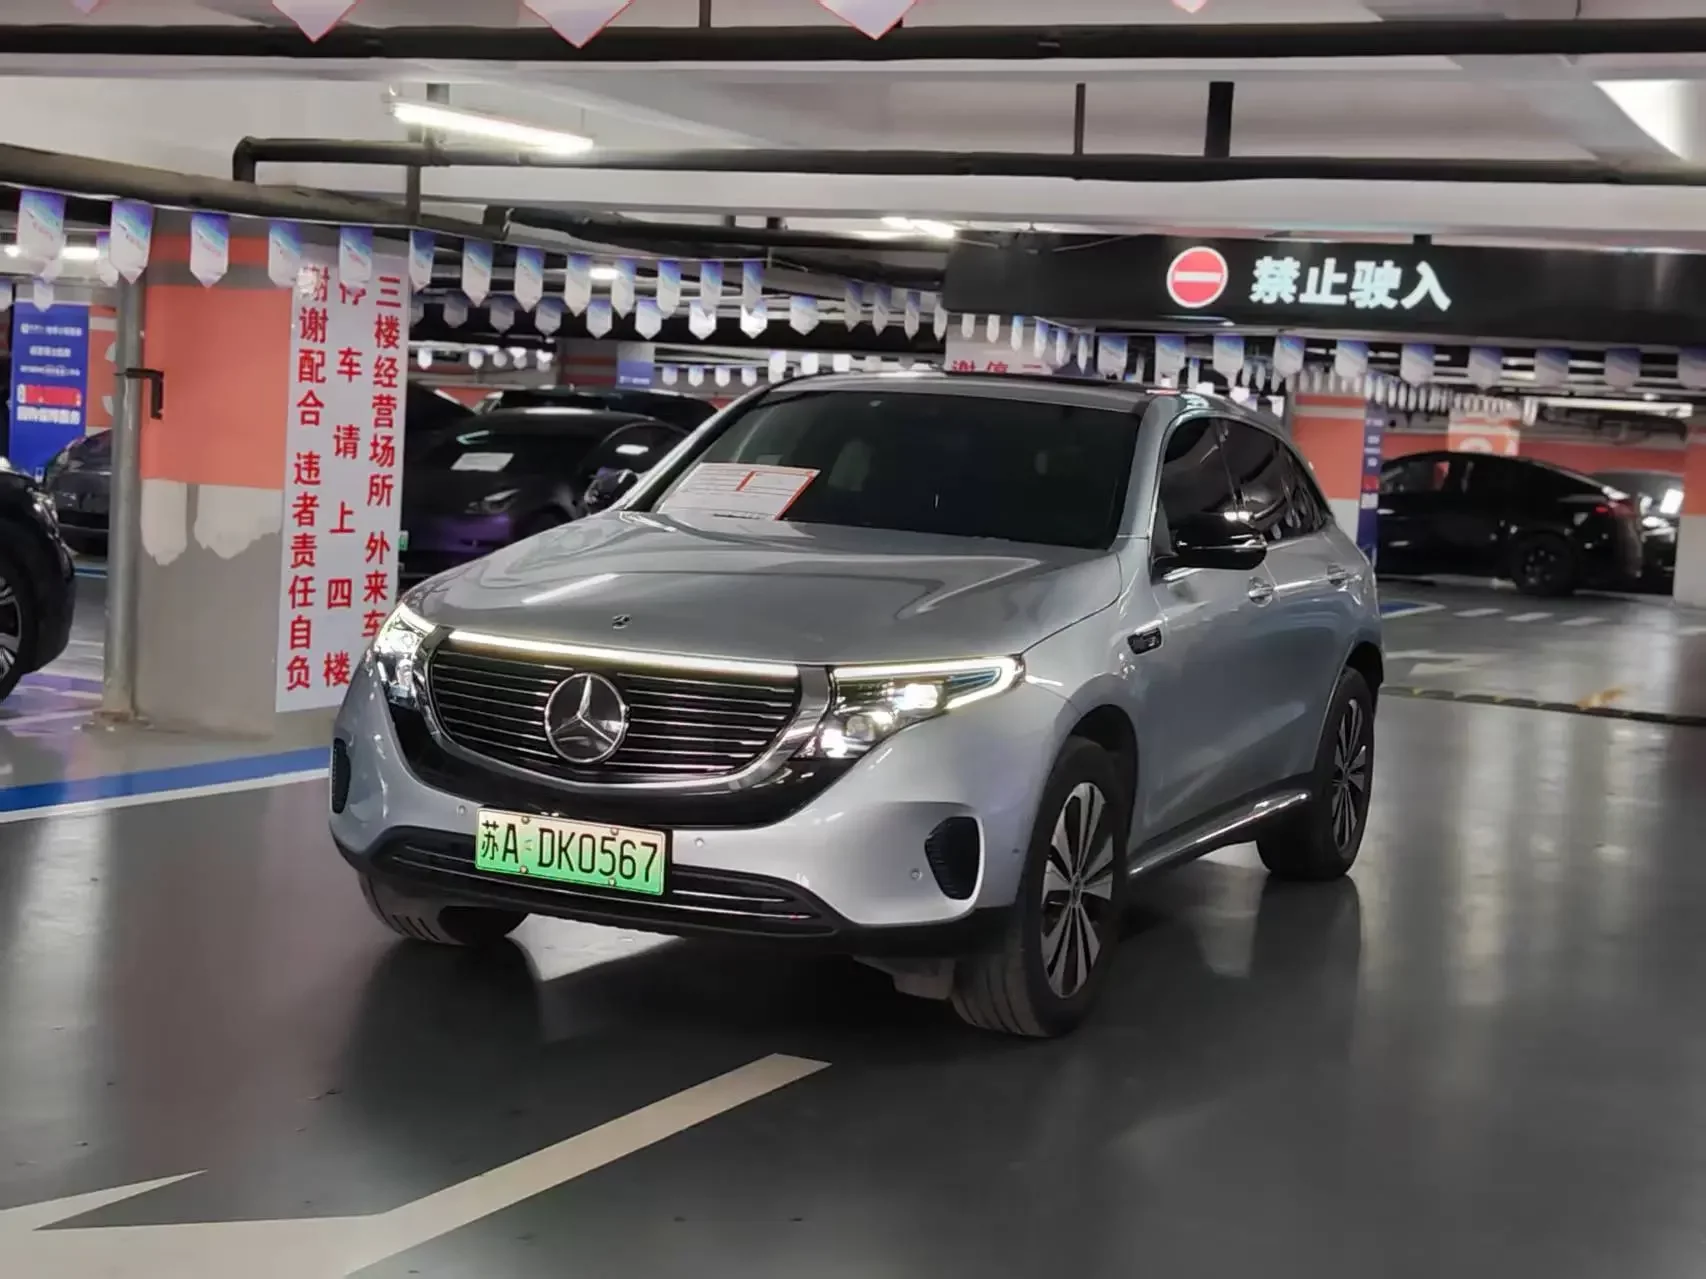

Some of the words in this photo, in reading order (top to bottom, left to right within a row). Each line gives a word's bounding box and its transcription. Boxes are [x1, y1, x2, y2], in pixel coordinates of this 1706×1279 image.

[1249, 256, 1452, 312] 禁止驶入
[366, 275, 402, 508] 三楼经营场所
[285, 450, 322, 692] 违者责任自负
[481, 819, 519, 864] 苏A
[537, 826, 658, 883] DK0567
